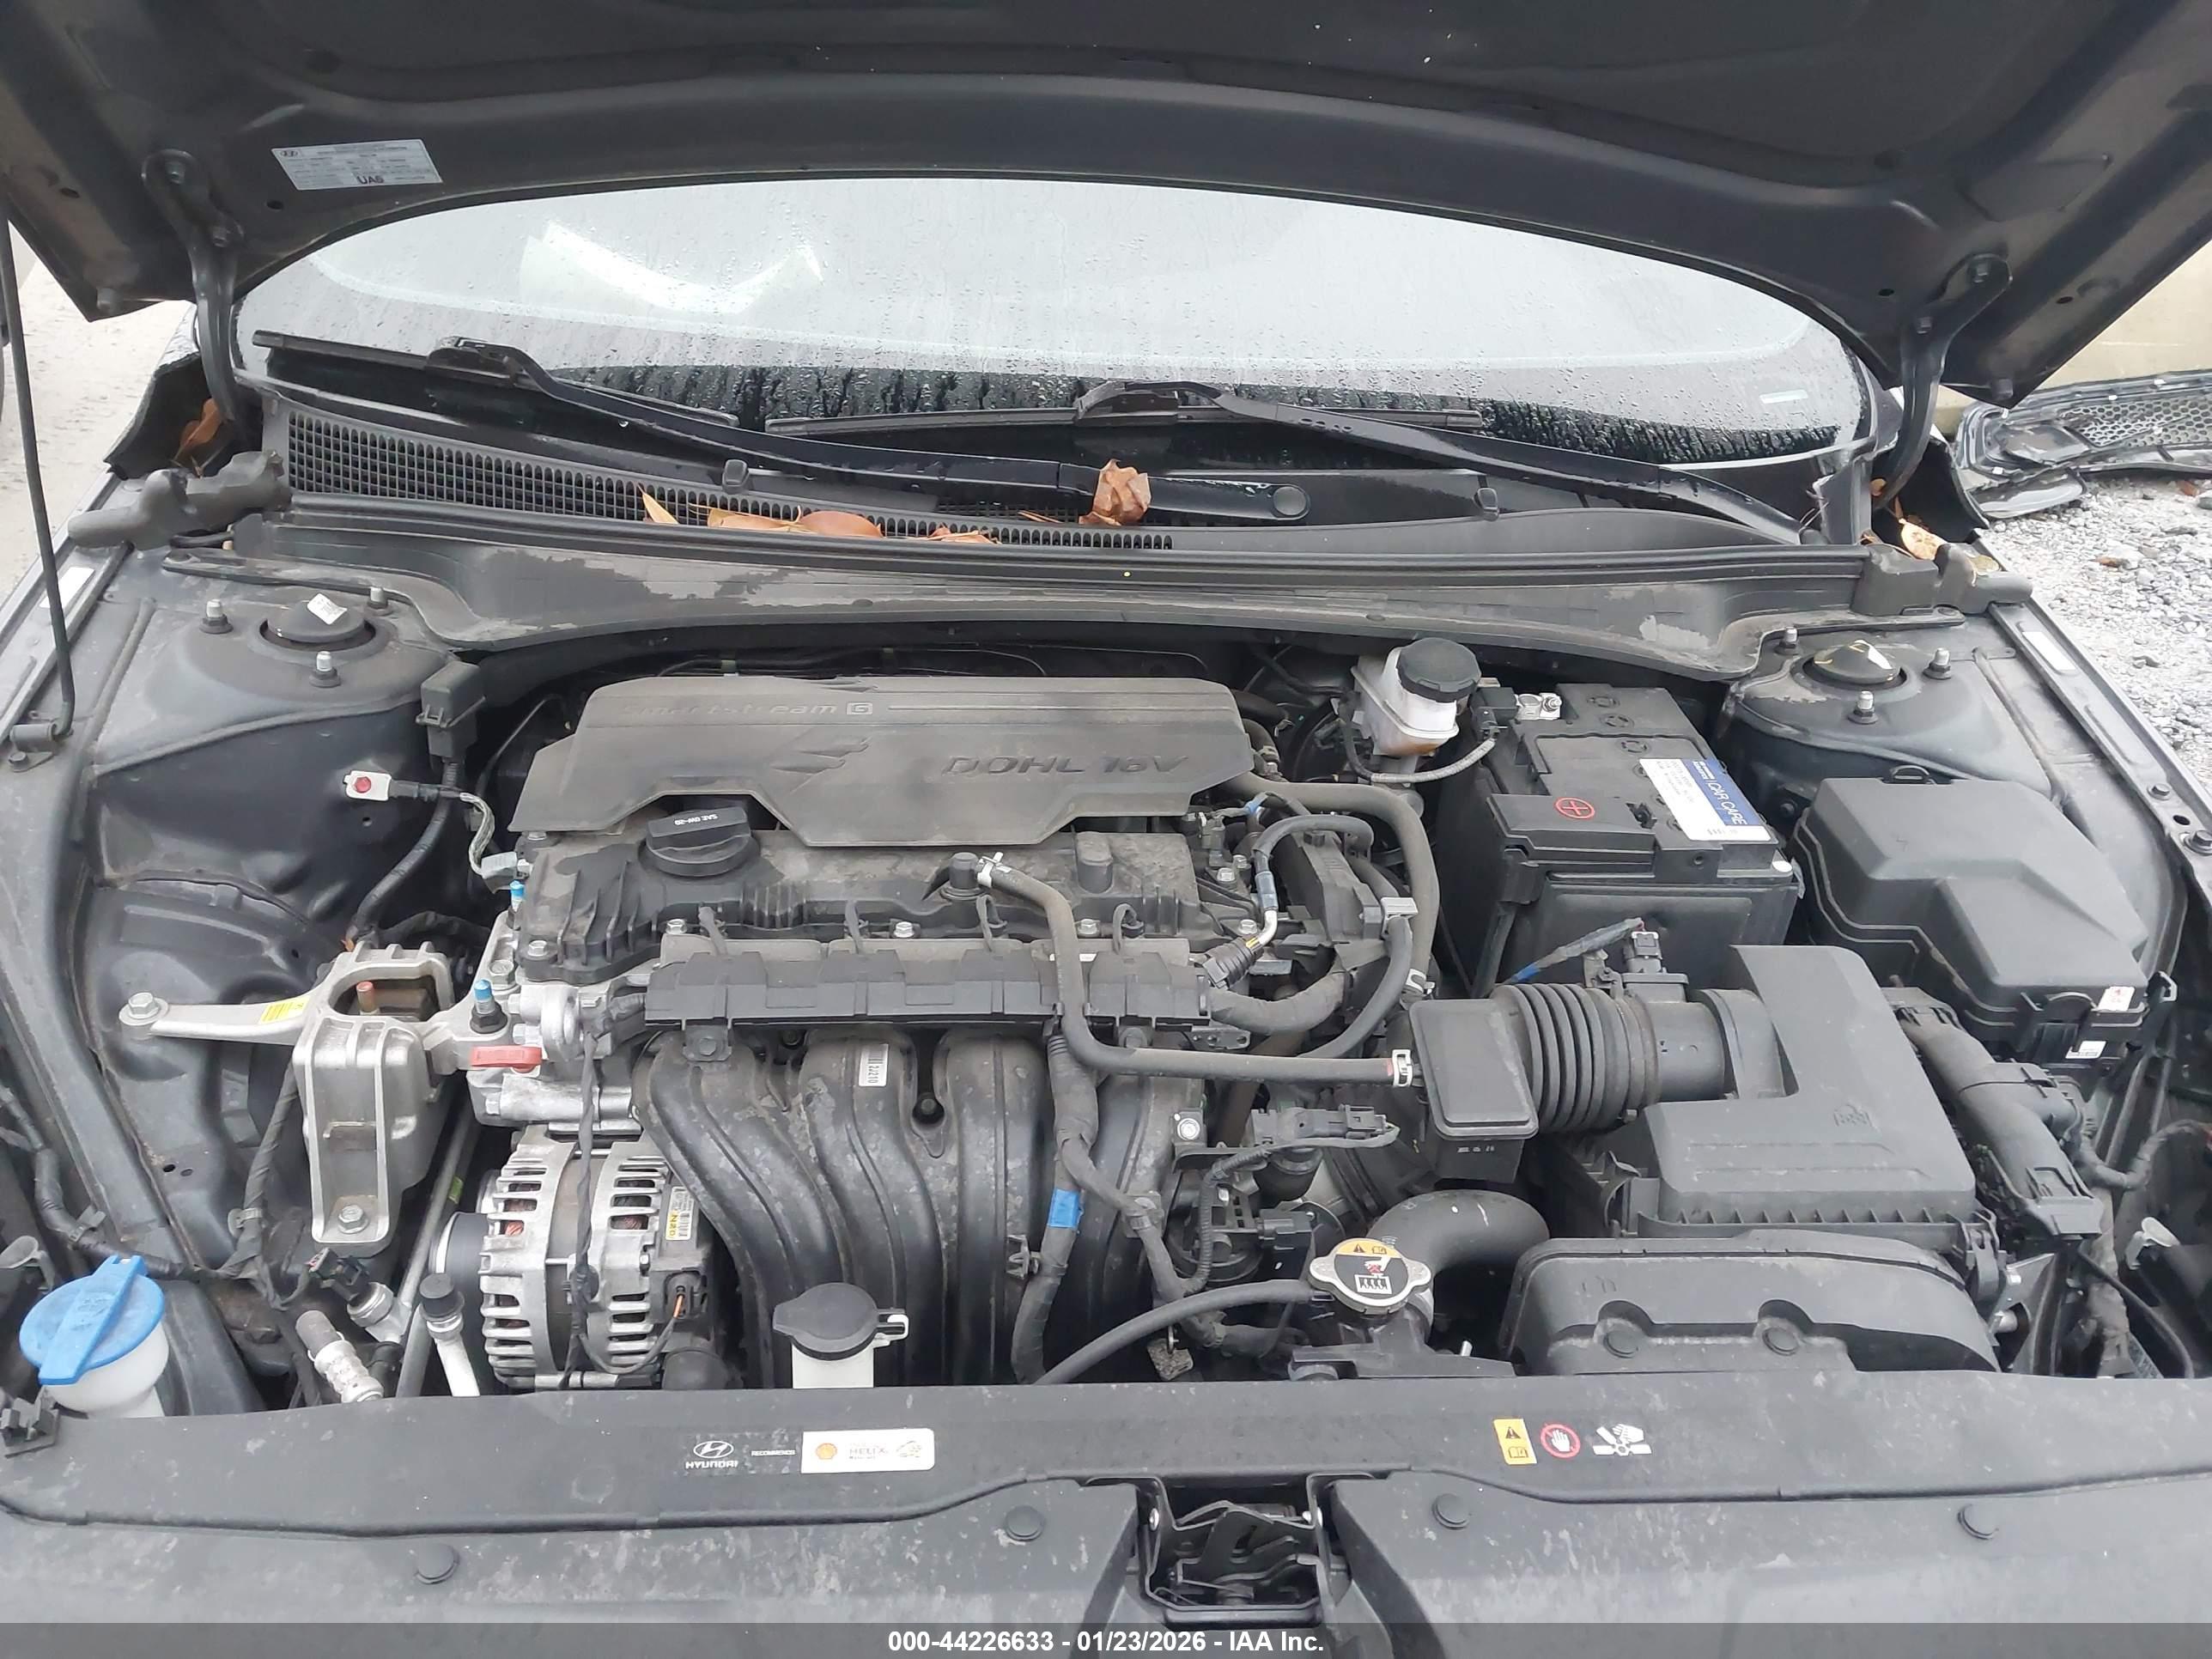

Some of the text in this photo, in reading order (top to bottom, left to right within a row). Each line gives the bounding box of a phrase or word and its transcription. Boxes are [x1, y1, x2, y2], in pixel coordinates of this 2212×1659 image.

[1098, 756, 1189, 774] 16V
[1707, 780, 1729, 802] CAR
[1722, 799, 1748, 825] CARE
[685, 1460, 738, 1469] HYUNDAI
